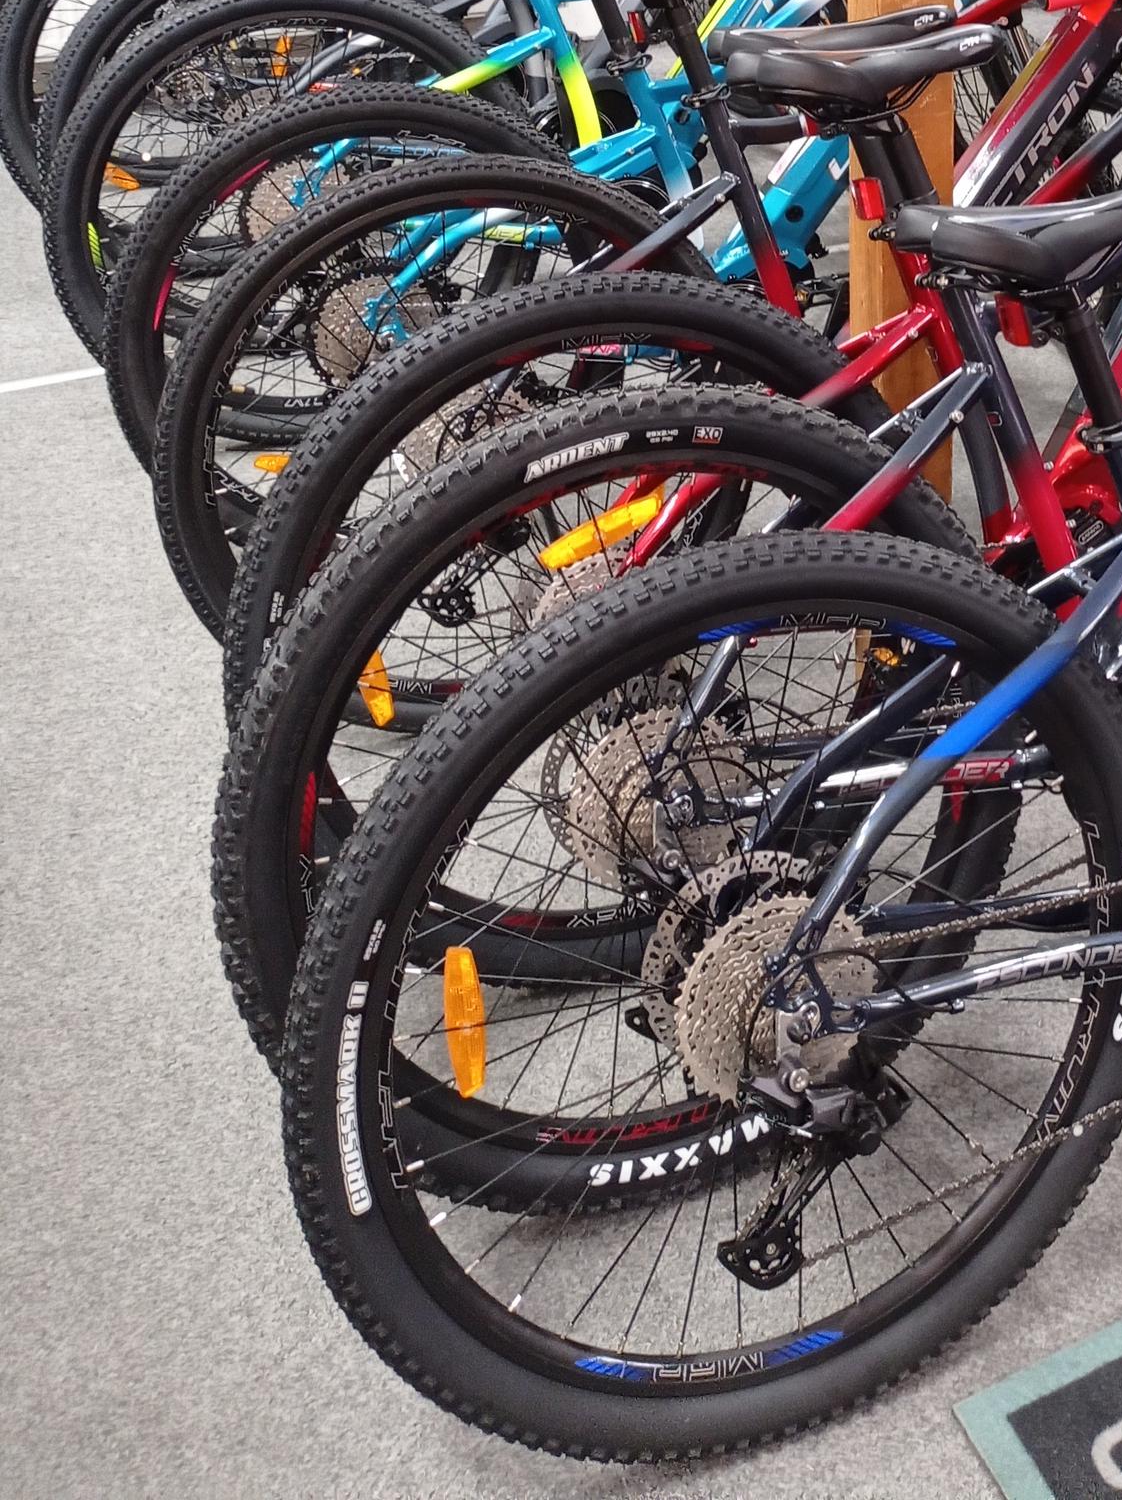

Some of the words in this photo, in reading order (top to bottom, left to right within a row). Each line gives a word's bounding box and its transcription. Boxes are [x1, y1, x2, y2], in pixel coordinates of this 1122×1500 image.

[523, 431, 630, 484] ARDENT
[694, 426, 722, 441] EXO
[336, 1012, 372, 1217] CROSSMARK
[587, 1112, 771, 1188] MAXXIS
